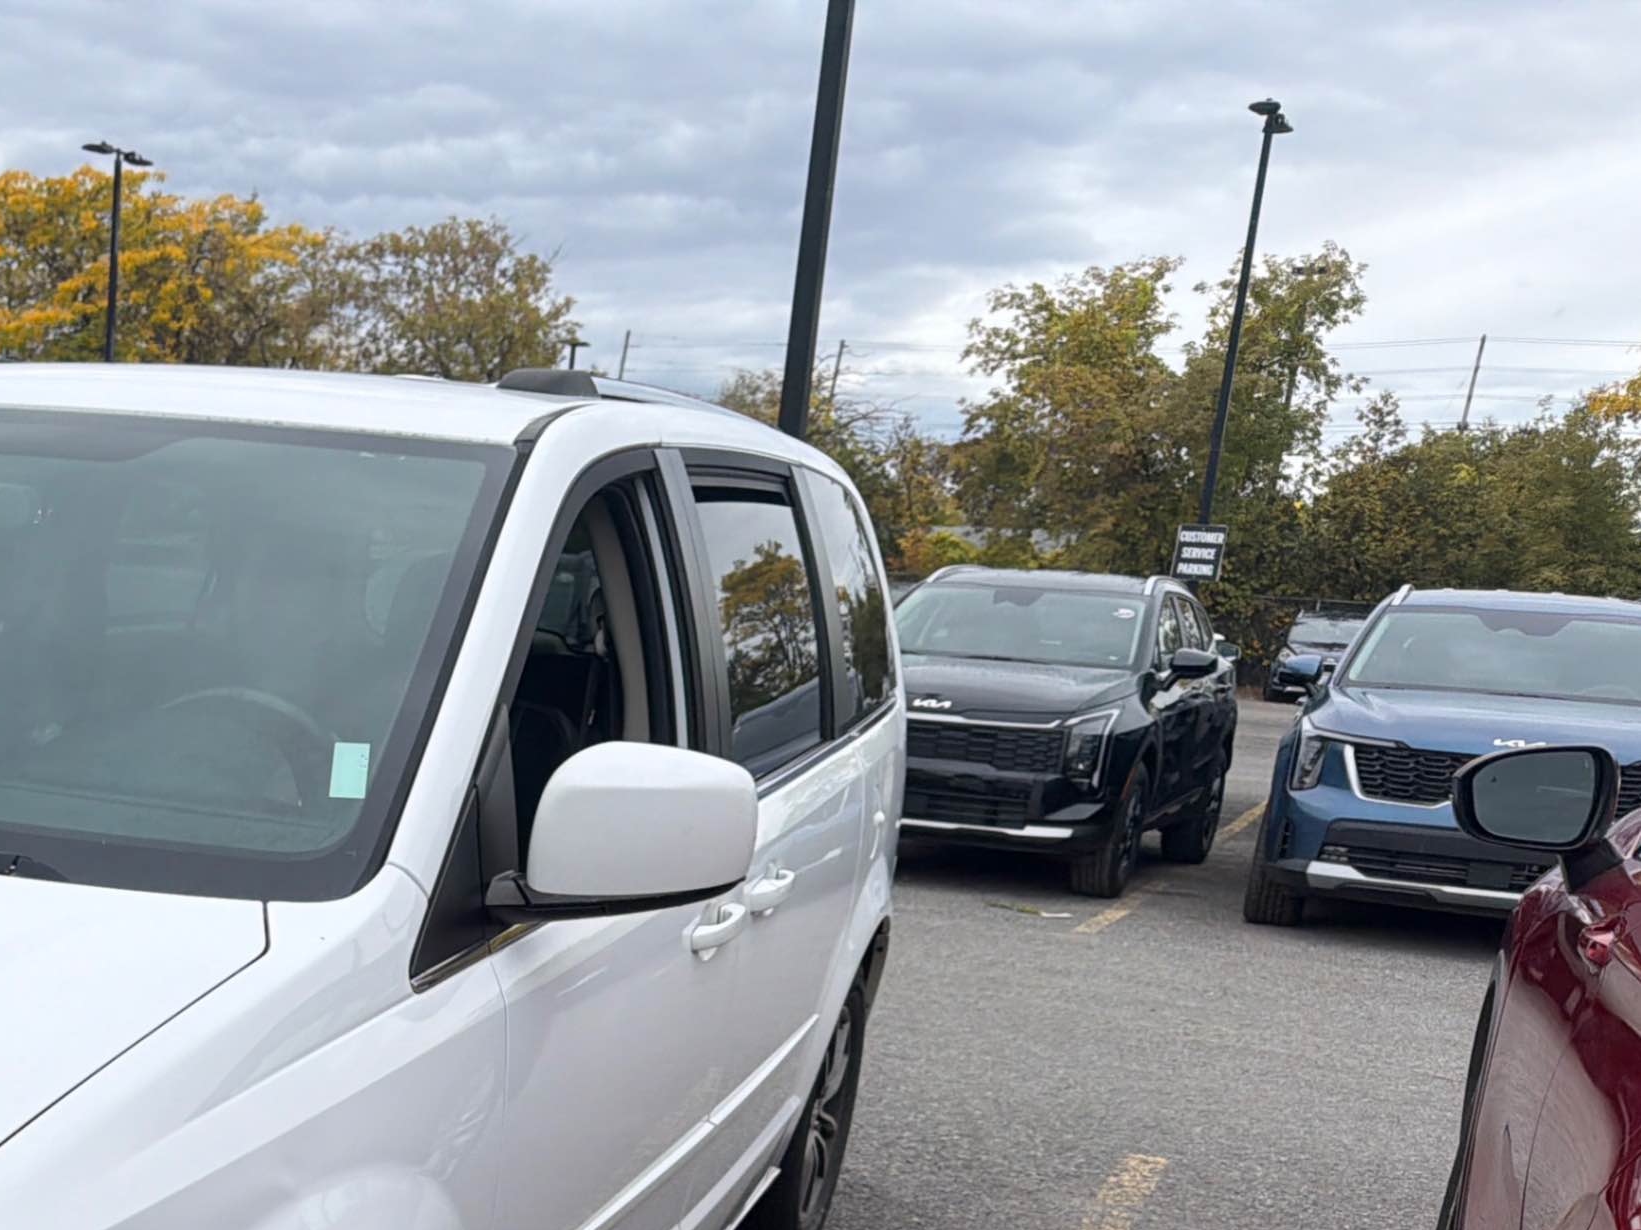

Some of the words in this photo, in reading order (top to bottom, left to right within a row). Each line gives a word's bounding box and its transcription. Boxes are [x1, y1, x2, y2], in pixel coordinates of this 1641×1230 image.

[1180, 530, 1225, 545] CUSTOMER
[1180, 546, 1217, 560] SERVICE
[1176, 562, 1215, 576] PARKING
